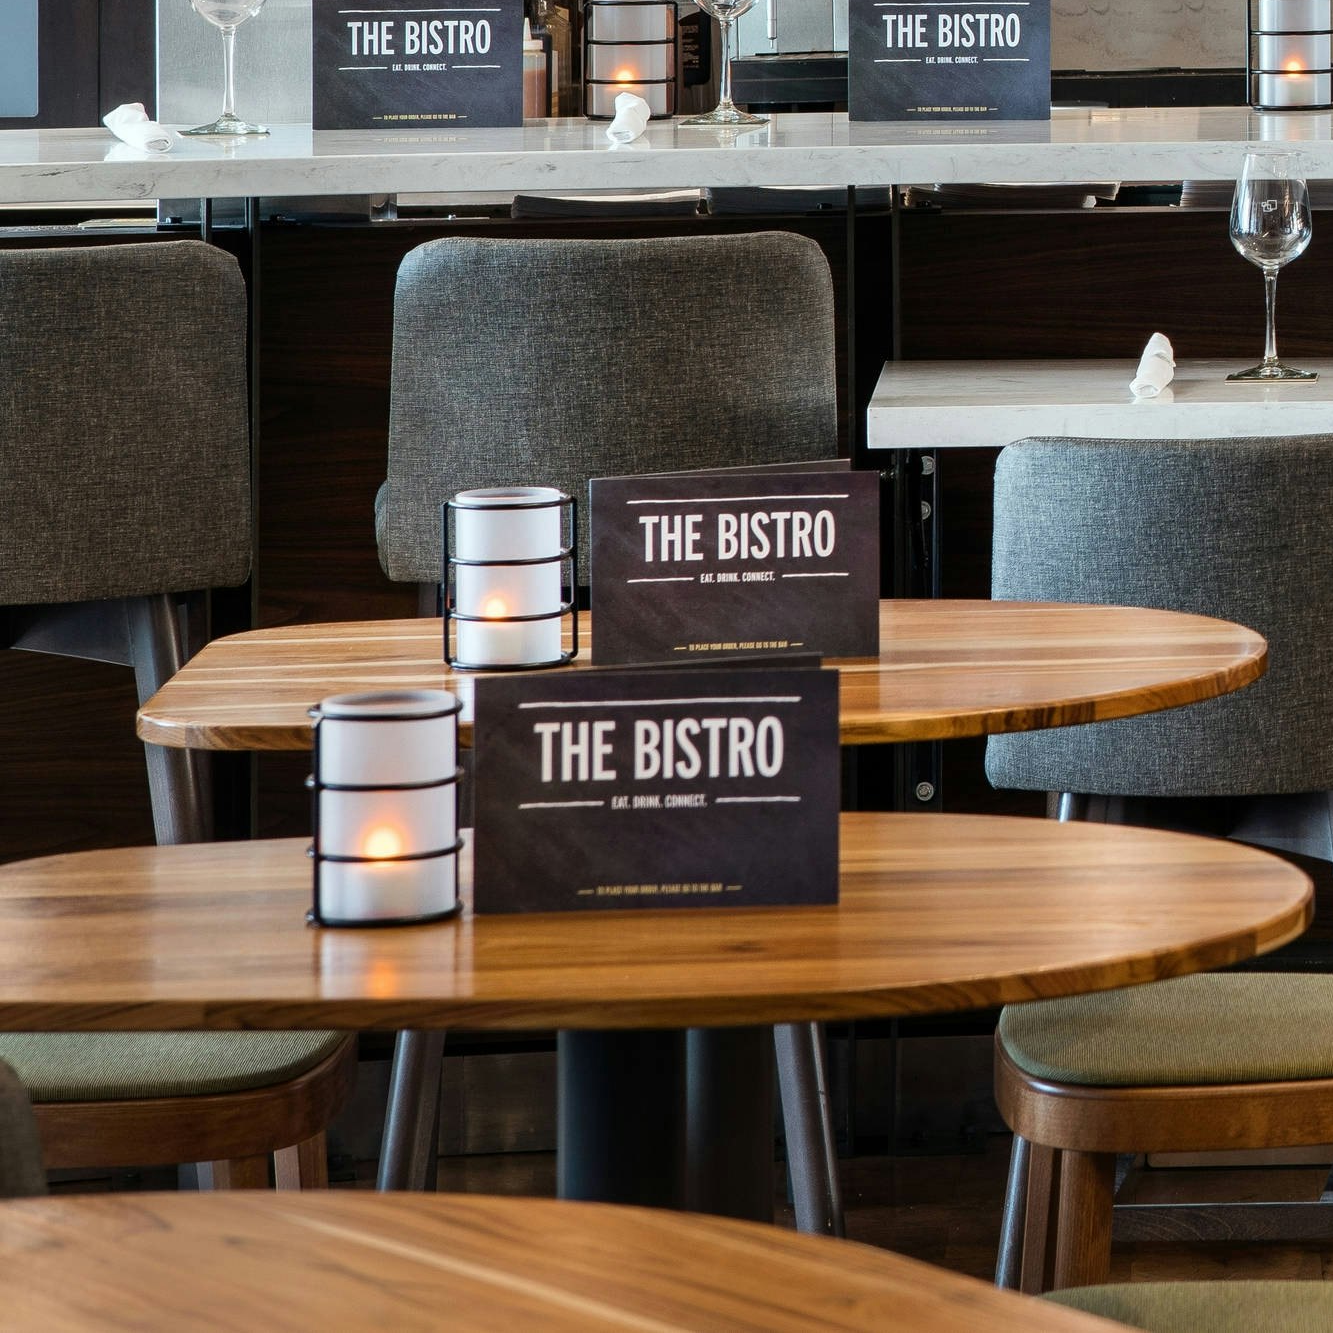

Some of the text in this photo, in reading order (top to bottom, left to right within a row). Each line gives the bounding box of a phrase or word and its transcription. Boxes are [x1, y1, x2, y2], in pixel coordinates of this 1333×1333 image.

[348, 20, 490, 55] THE BISTRO
[883, 13, 1020, 47] THE BISTRO
[639, 510, 835, 562] THE BISTRO
[534, 716, 783, 782] THE BISTRO
